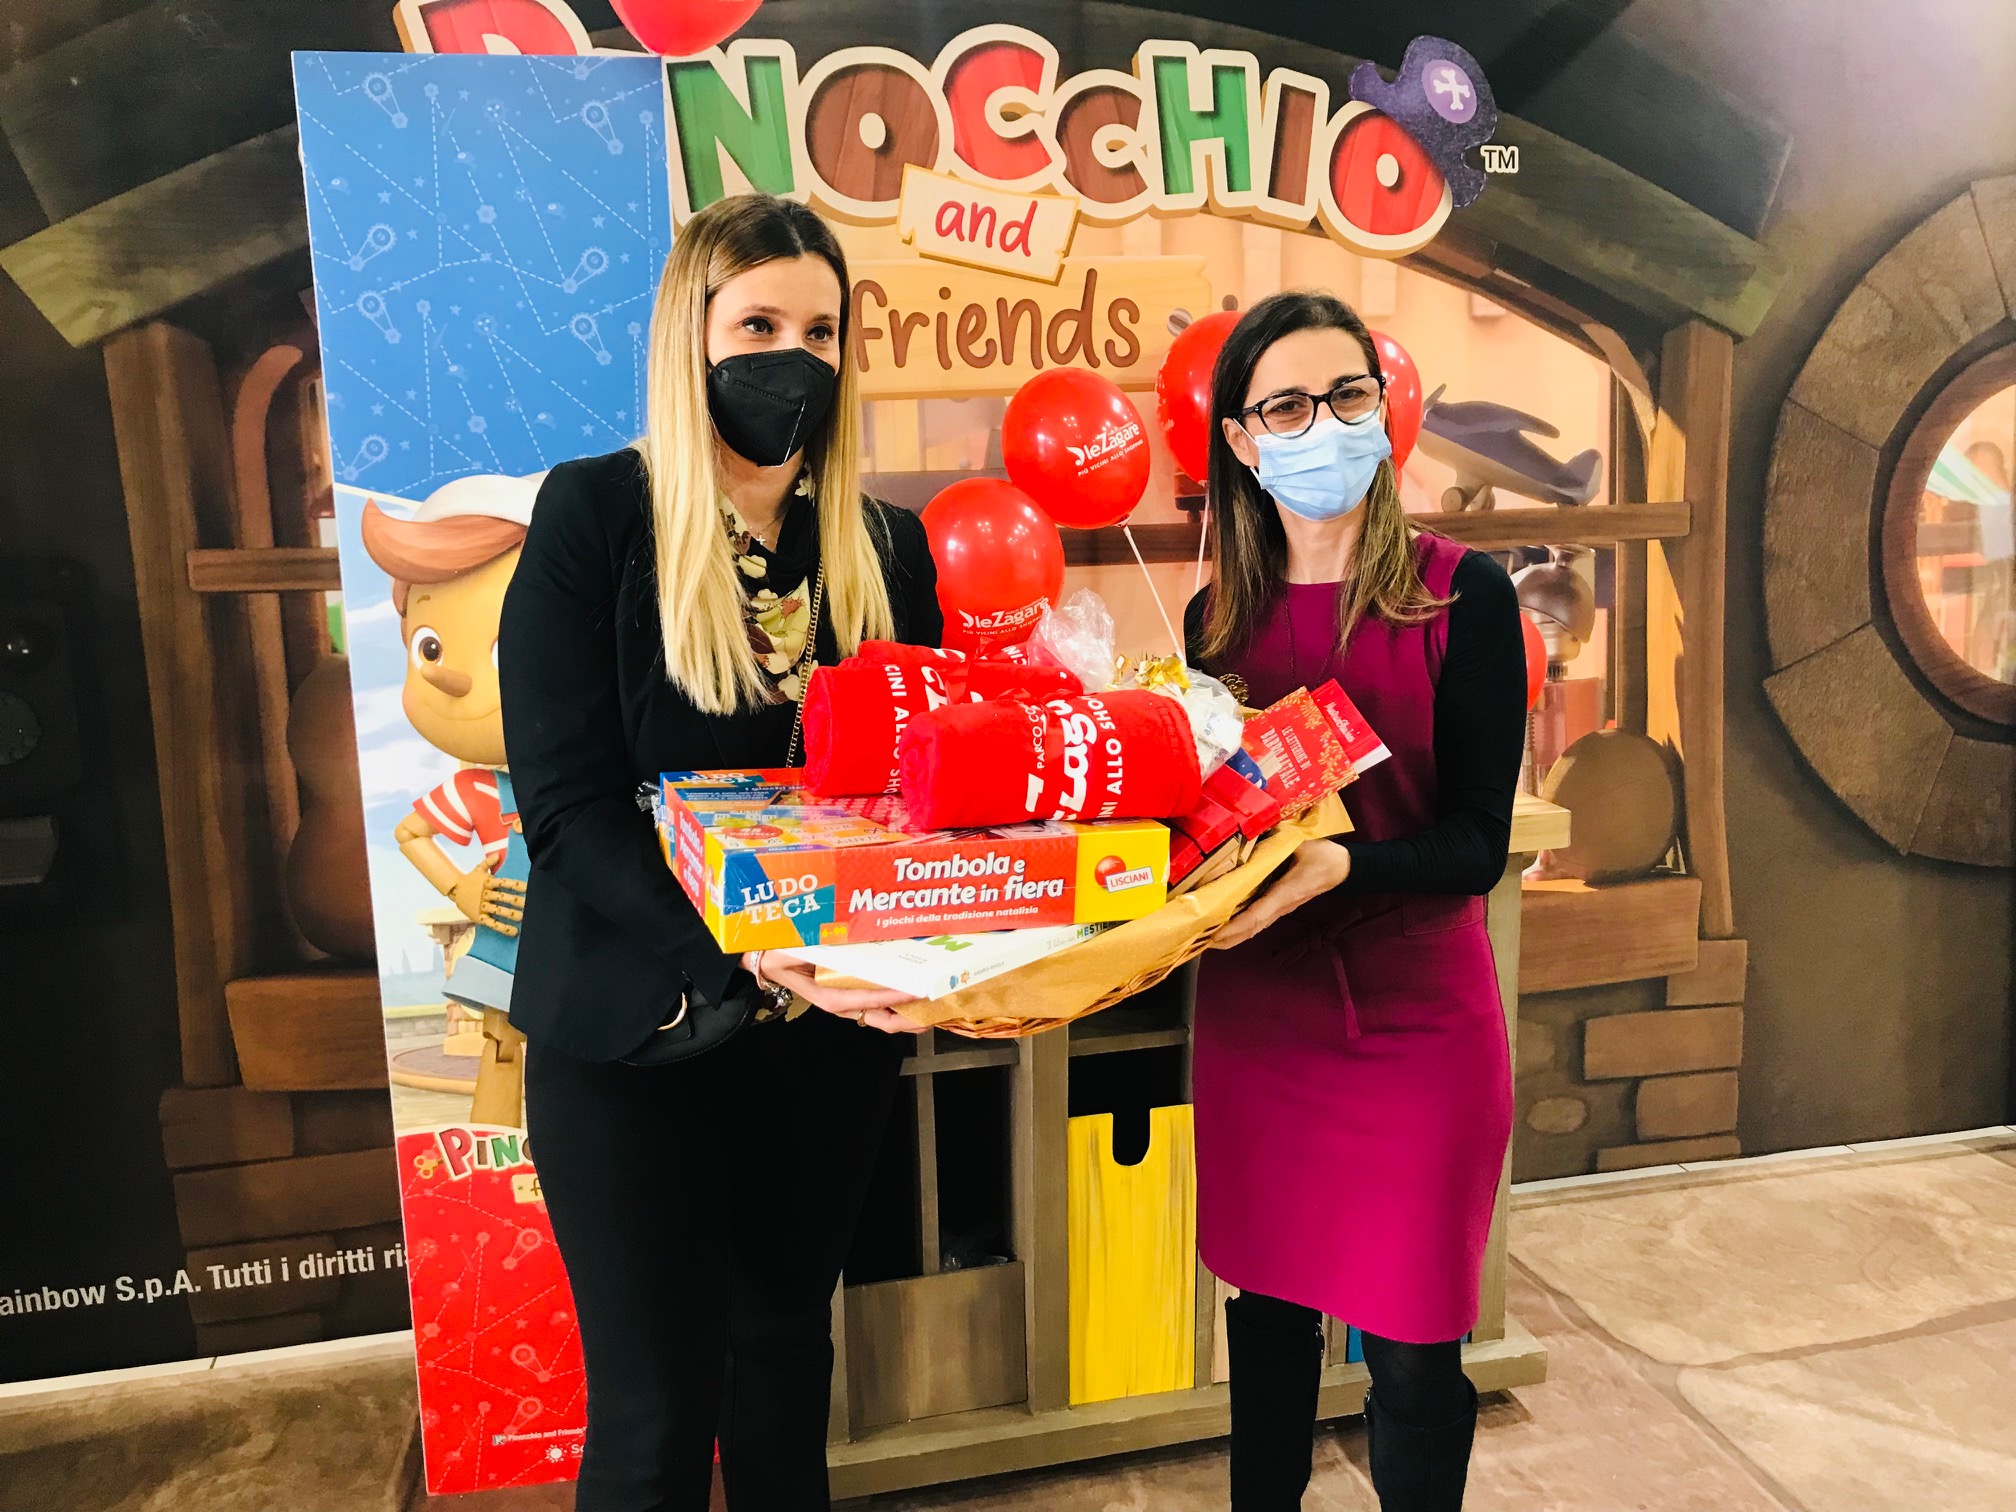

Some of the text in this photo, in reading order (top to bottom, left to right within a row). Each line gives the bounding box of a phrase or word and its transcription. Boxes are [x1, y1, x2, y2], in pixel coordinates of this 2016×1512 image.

[424, 0, 1517, 237] NOCCHIO TM
[935, 200, 1038, 257] and
[852, 267, 1140, 373] friends
[1083, 423, 1139, 460] leZagare
[1078, 468, 1089, 476] PIÙ
[1090, 458, 1109, 471] VICINI
[1110, 451, 1124, 461] ALLO
[1000, 626, 1017, 634] ALLO
[1032, 726, 1045, 769] PARCO
[1105, 738, 1123, 795] ALLO
[1281, 725, 1311, 771] LE LETTERINE DI
[893, 851, 1026, 882] Tombola e
[1110, 871, 1149, 888] LISCIANI
[744, 893, 821, 924] TECA
[848, 875, 1064, 914] Mercante in fiera
[876, 905, 1039, 929] I giochi della tradizione natalizia
[115, 1269, 201, 1304] S.p.A.
[206, 1258, 272, 1290] Tutti
[280, 1256, 290, 1282] i
[299, 1246, 376, 1280] diritti
[384, 1243, 408, 1270] ri
